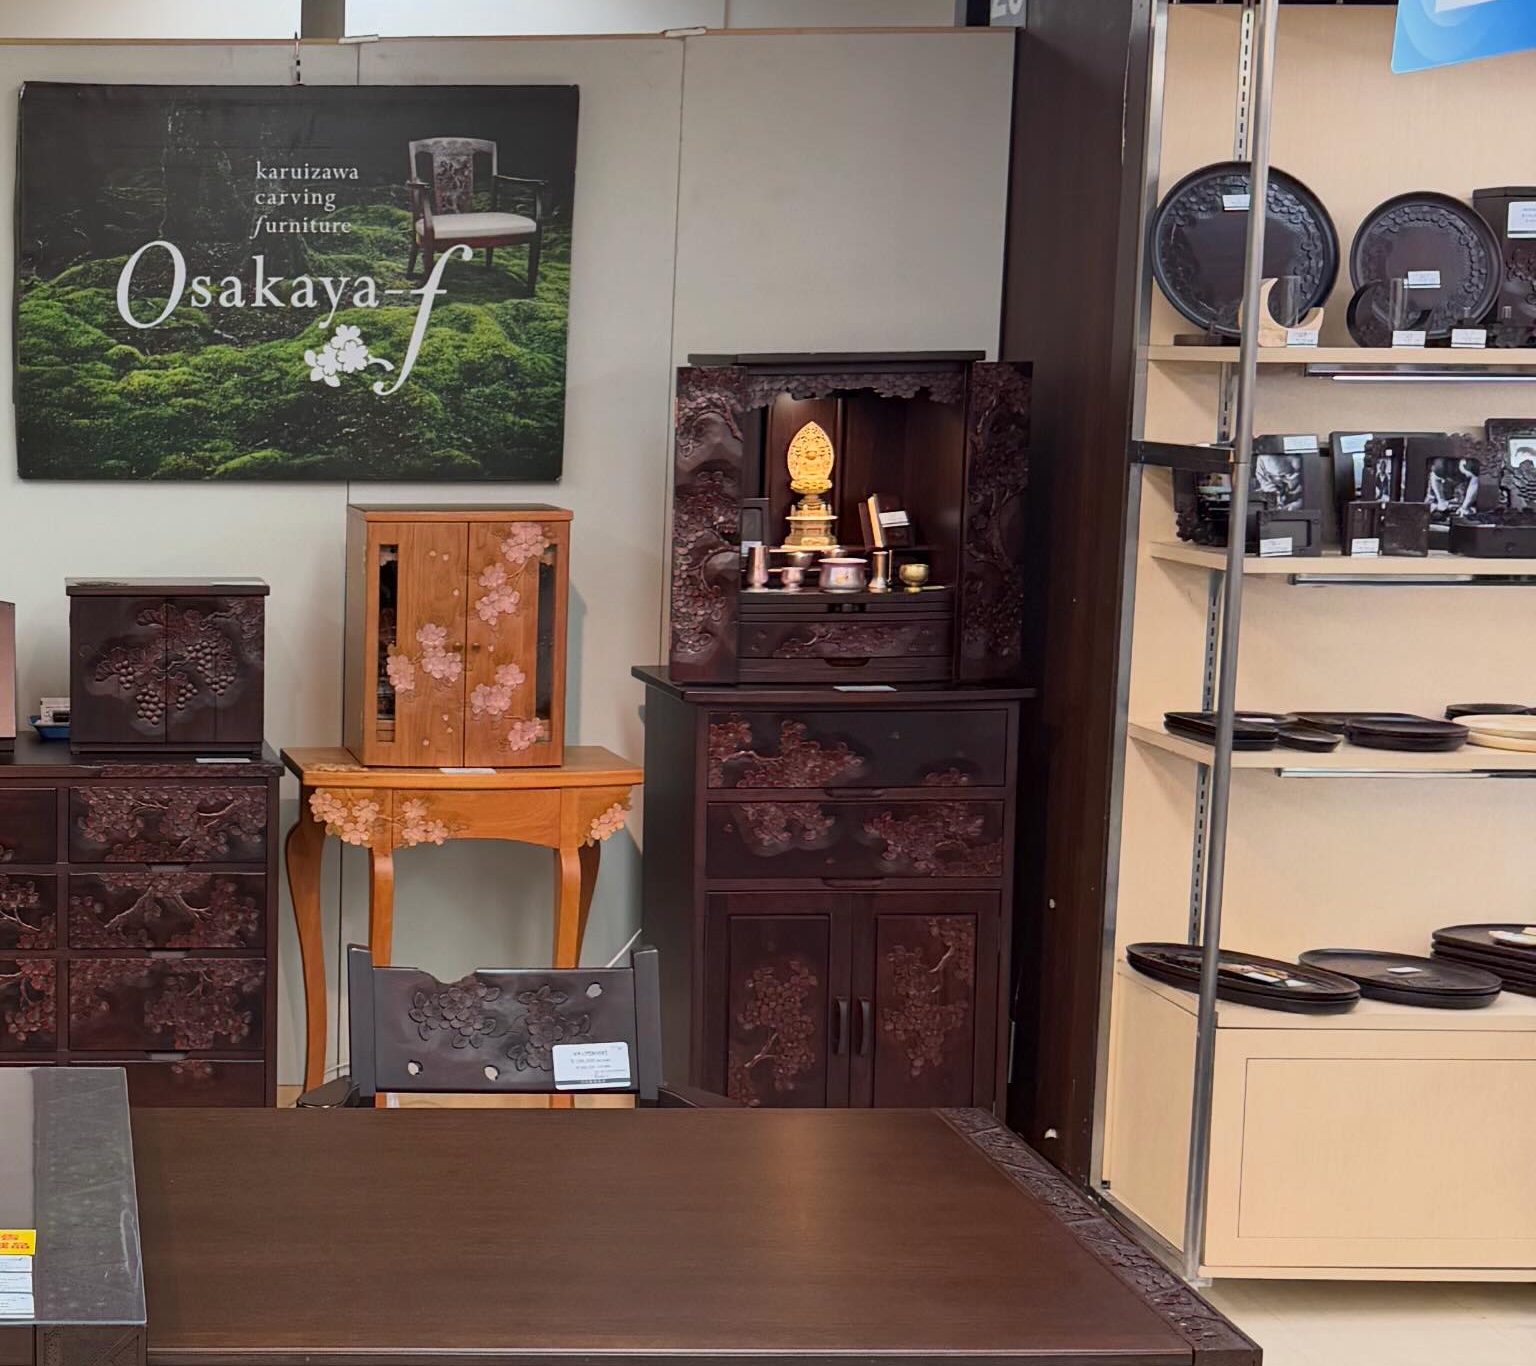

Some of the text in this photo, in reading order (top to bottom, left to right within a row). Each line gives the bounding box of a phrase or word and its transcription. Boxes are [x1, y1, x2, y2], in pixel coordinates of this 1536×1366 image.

[256, 161, 359, 181] karuizawa
[255, 189, 337, 212] carving
[249, 215, 352, 239] furniture
